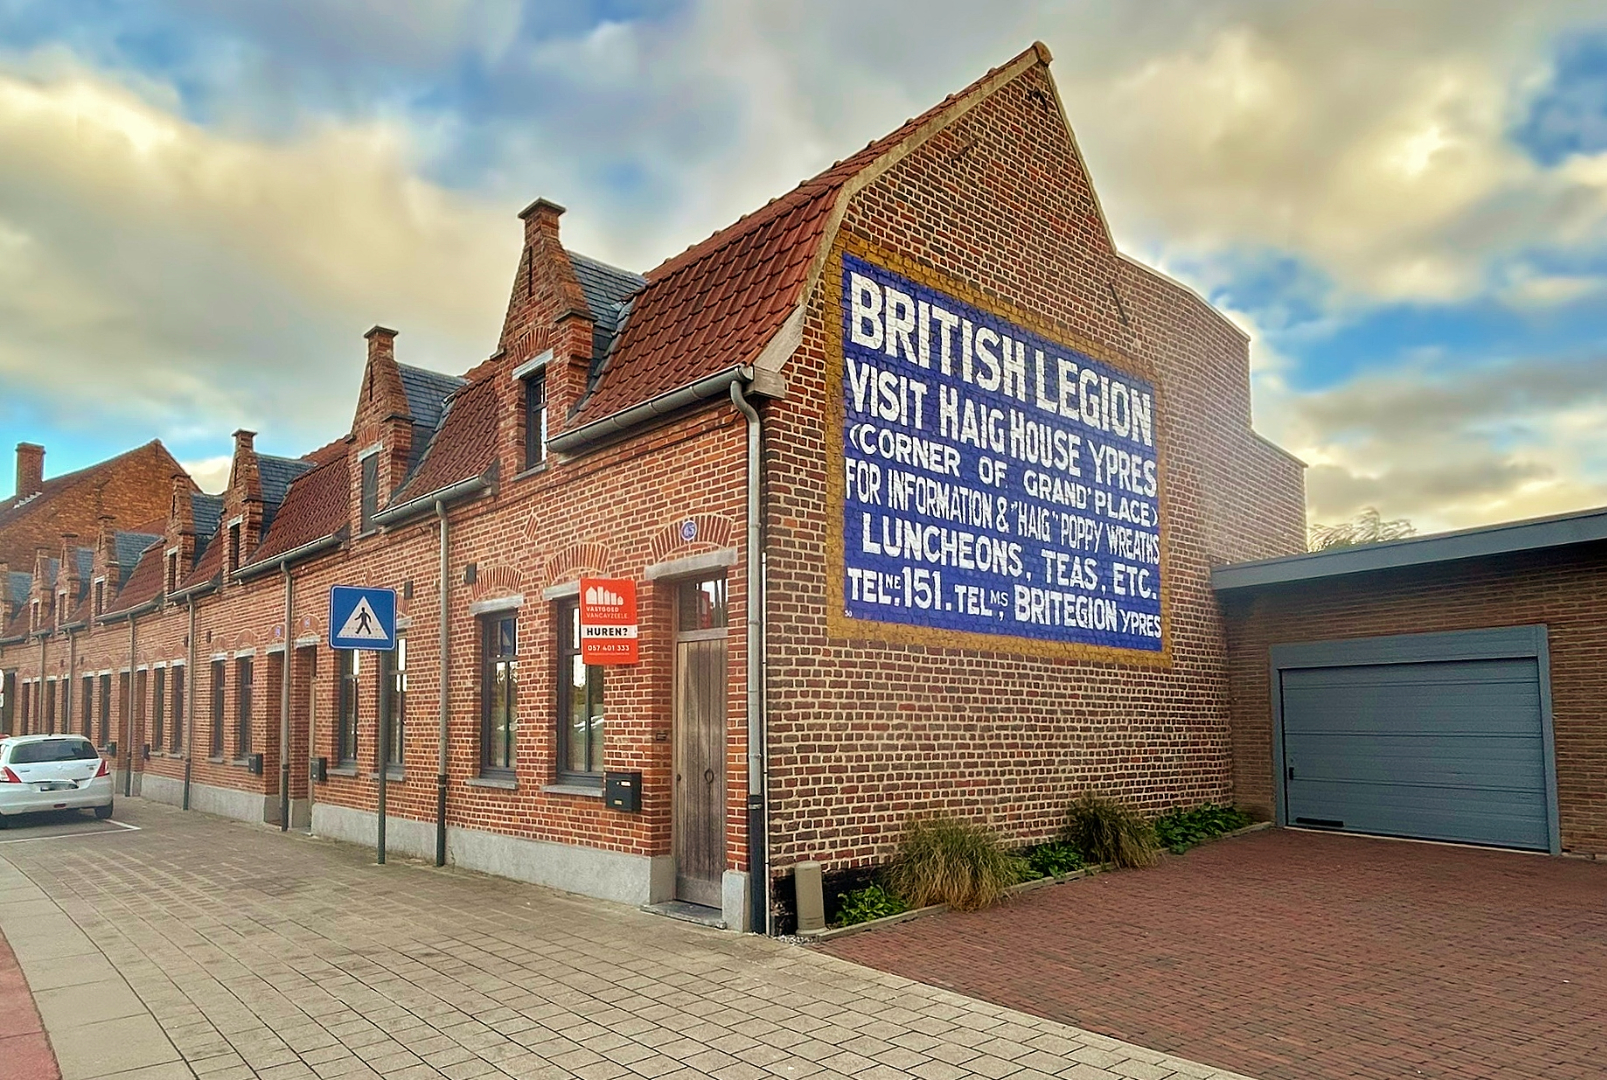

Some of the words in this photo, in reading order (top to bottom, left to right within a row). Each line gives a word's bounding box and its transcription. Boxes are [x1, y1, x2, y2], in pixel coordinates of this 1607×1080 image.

[850, 271, 1027, 400] BRITISH
[1033, 349, 1153, 447] LEGION
[845, 358, 927, 430] VISIT
[939, 384, 1005, 454] HAIG
[1009, 406, 1081, 477] HOUSE
[1087, 439, 1158, 498] YPRES
[849, 423, 961, 477] (CORNER
[978, 456, 1008, 488] OF
[845, 456, 881, 506] FOR
[887, 468, 993, 529] INFORMATION
[995, 496, 1010, 533] &
[1060, 512, 1104, 554] POPPY
[1105, 522, 1161, 565] WREATHS
[862, 511, 1032, 582] LUNCHEONS,
[1041, 549, 1106, 596] TEAS,
[1112, 561, 1158, 600] ETC.
[585, 605, 620, 613] VASTGOED
[586, 627, 628, 636] HUREN?
[1013, 584, 1118, 632] BRITEGION
[1118, 609, 1163, 638] YPRES
[587, 644, 601, 652] 057
[602, 644, 615, 652] 401
[616, 644, 630, 652] 333
